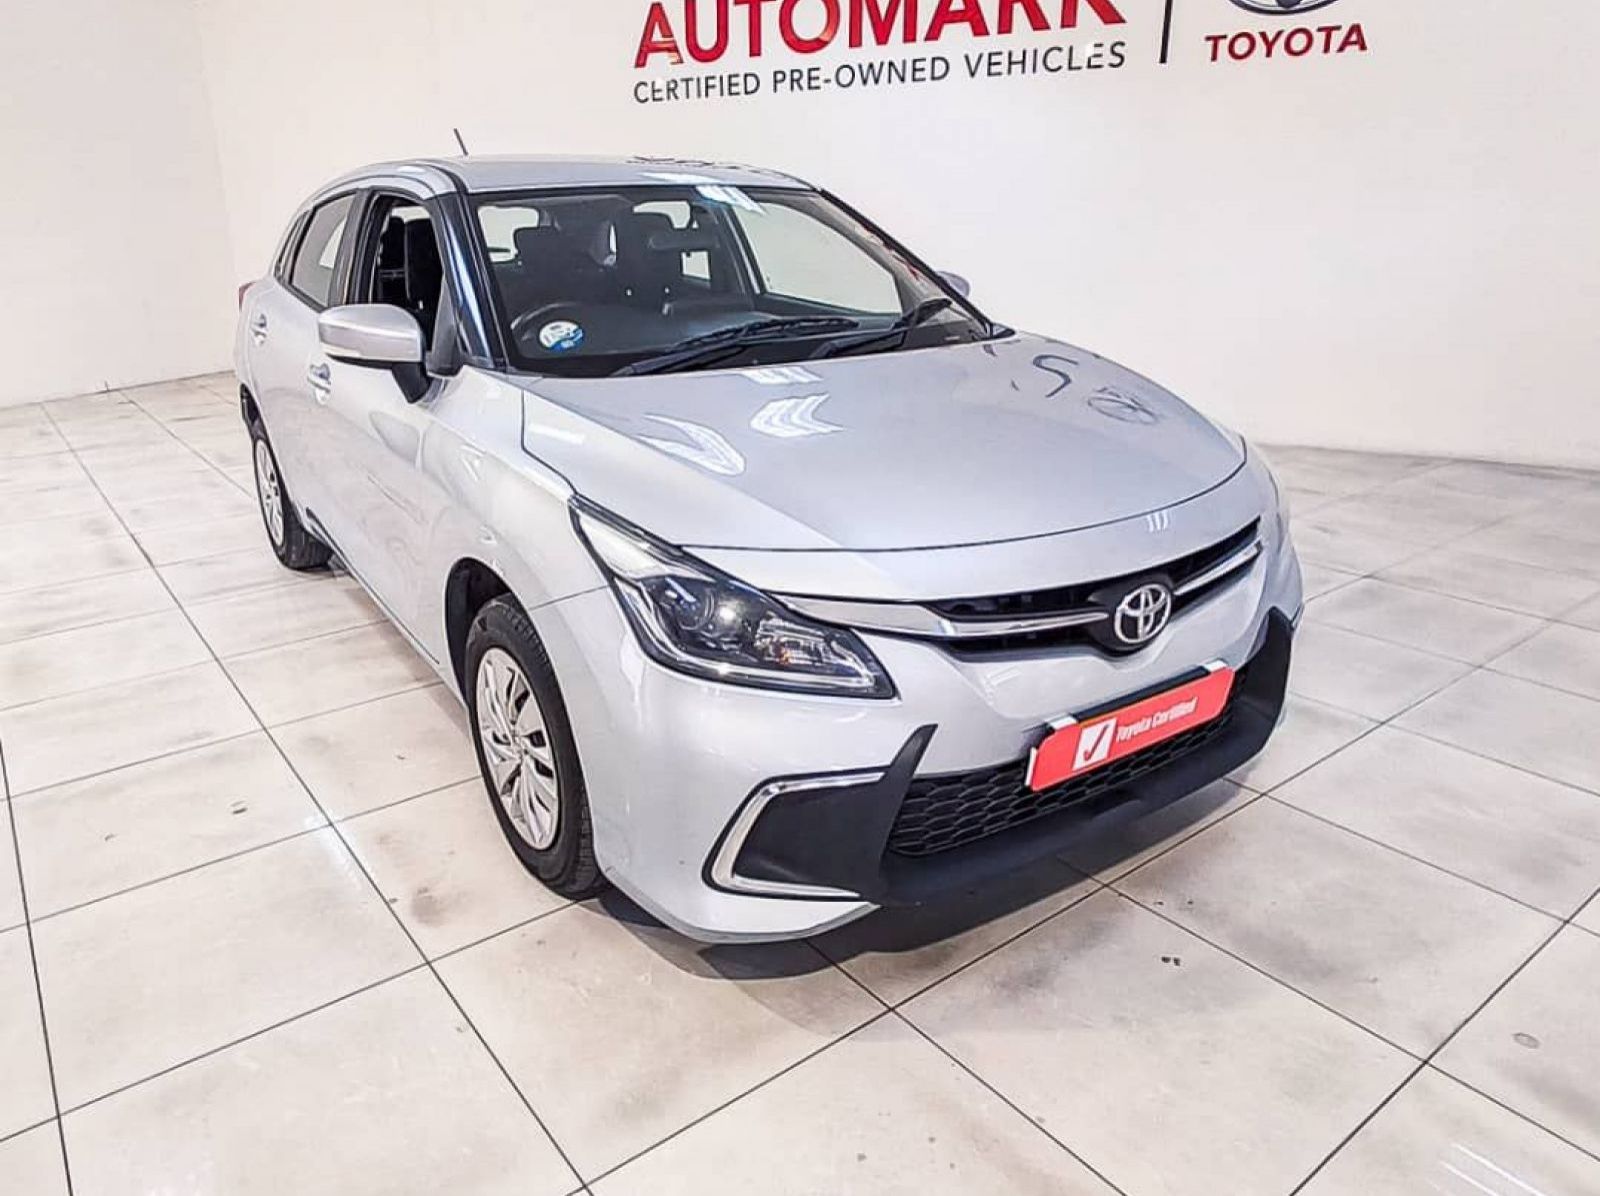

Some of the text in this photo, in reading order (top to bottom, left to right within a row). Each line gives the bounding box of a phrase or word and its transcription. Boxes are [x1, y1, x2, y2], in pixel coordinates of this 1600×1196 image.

[1204, 22, 1368, 63] TOYOTA
[633, 41, 1127, 104] CERTIFIED PRE-OWNED VEHICLES
